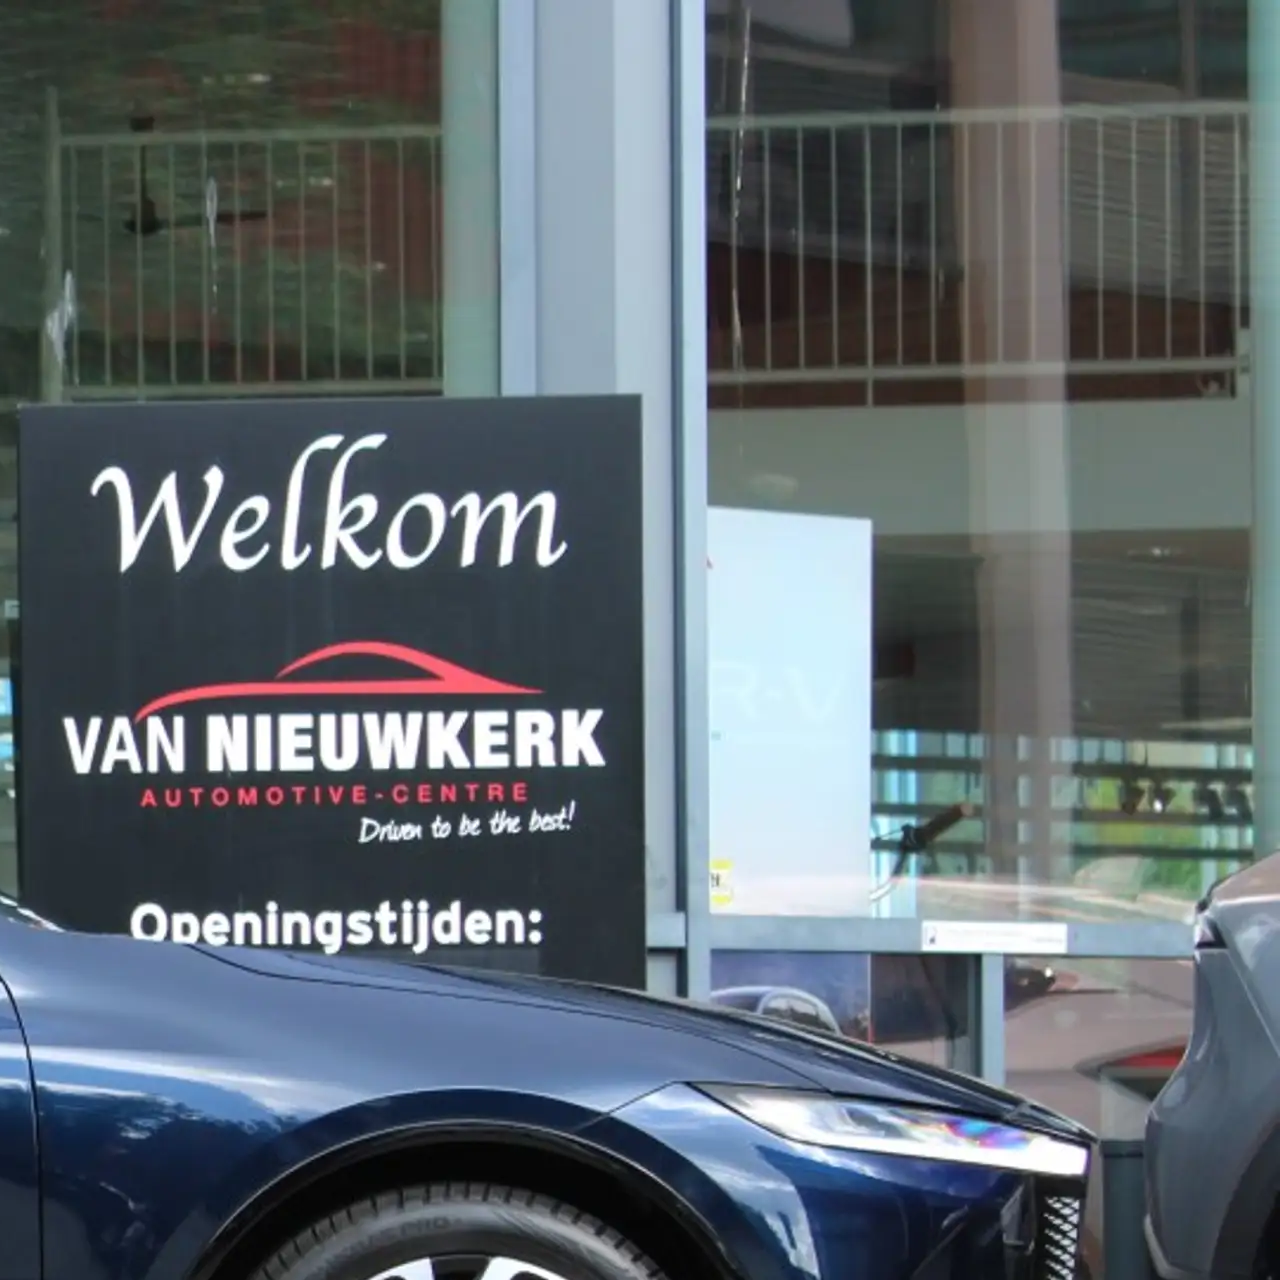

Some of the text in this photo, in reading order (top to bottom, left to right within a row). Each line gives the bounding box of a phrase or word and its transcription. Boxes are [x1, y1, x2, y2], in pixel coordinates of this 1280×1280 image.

[90, 432, 568, 574] Welkom
[62, 708, 607, 775] VAN NIEUWKERK
[139, 782, 529, 808] AUTOMOTIVE-CENTRE
[358, 799, 576, 844] Driven to be the best!
[130, 900, 543, 955] Openingstijden:
